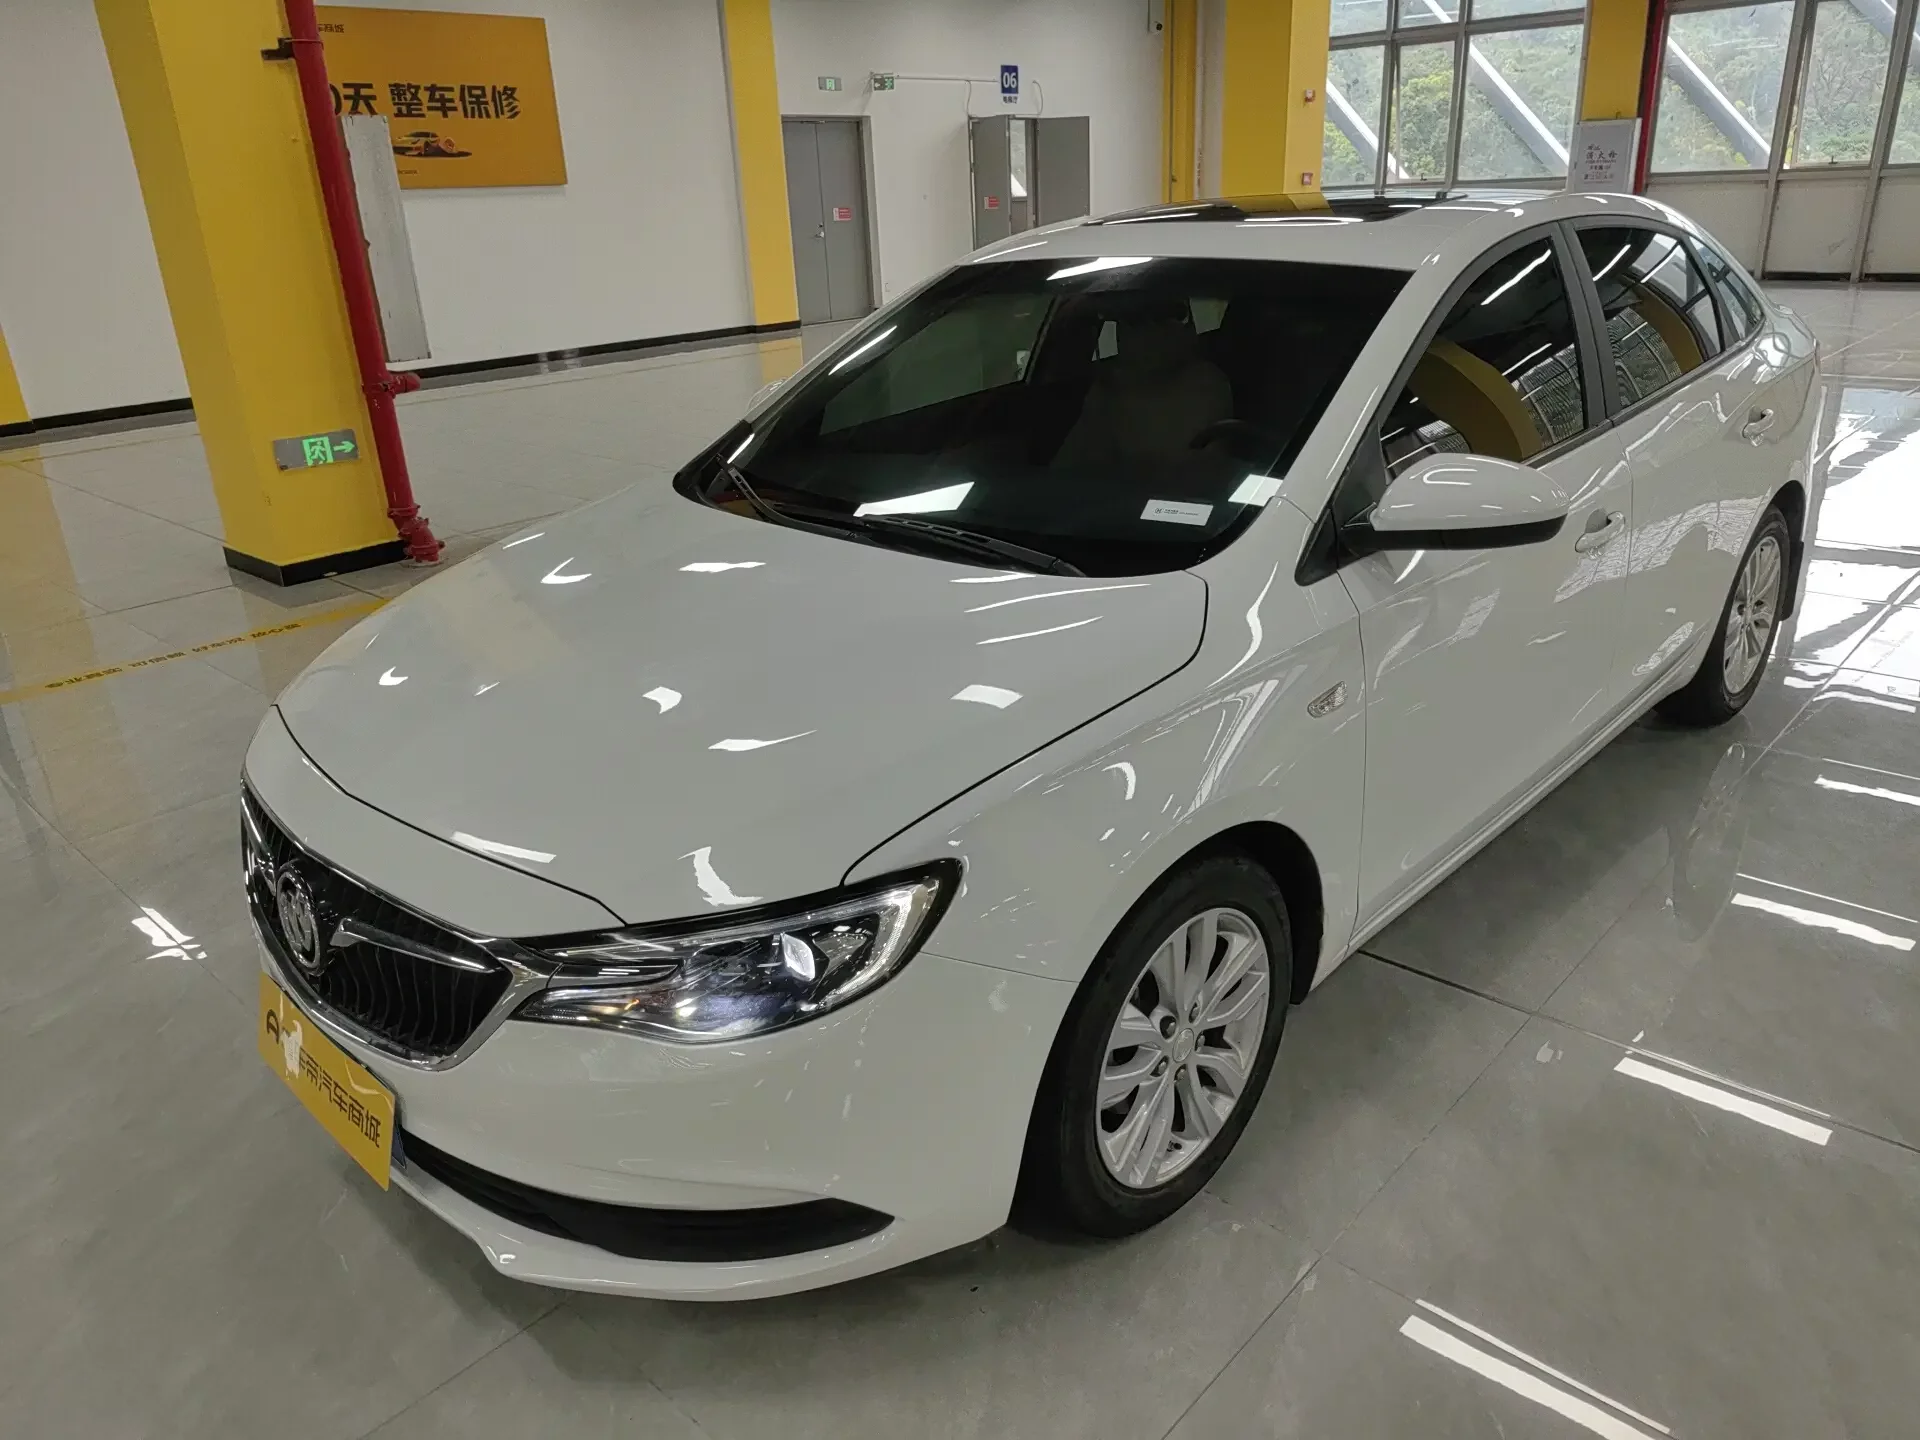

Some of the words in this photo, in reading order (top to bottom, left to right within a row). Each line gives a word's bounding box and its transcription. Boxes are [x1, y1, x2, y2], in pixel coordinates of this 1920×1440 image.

[1003, 72, 1017, 88] 06
[388, 82, 522, 120] 整车保修
[282, 1027, 382, 1149] 帝汽车商城
